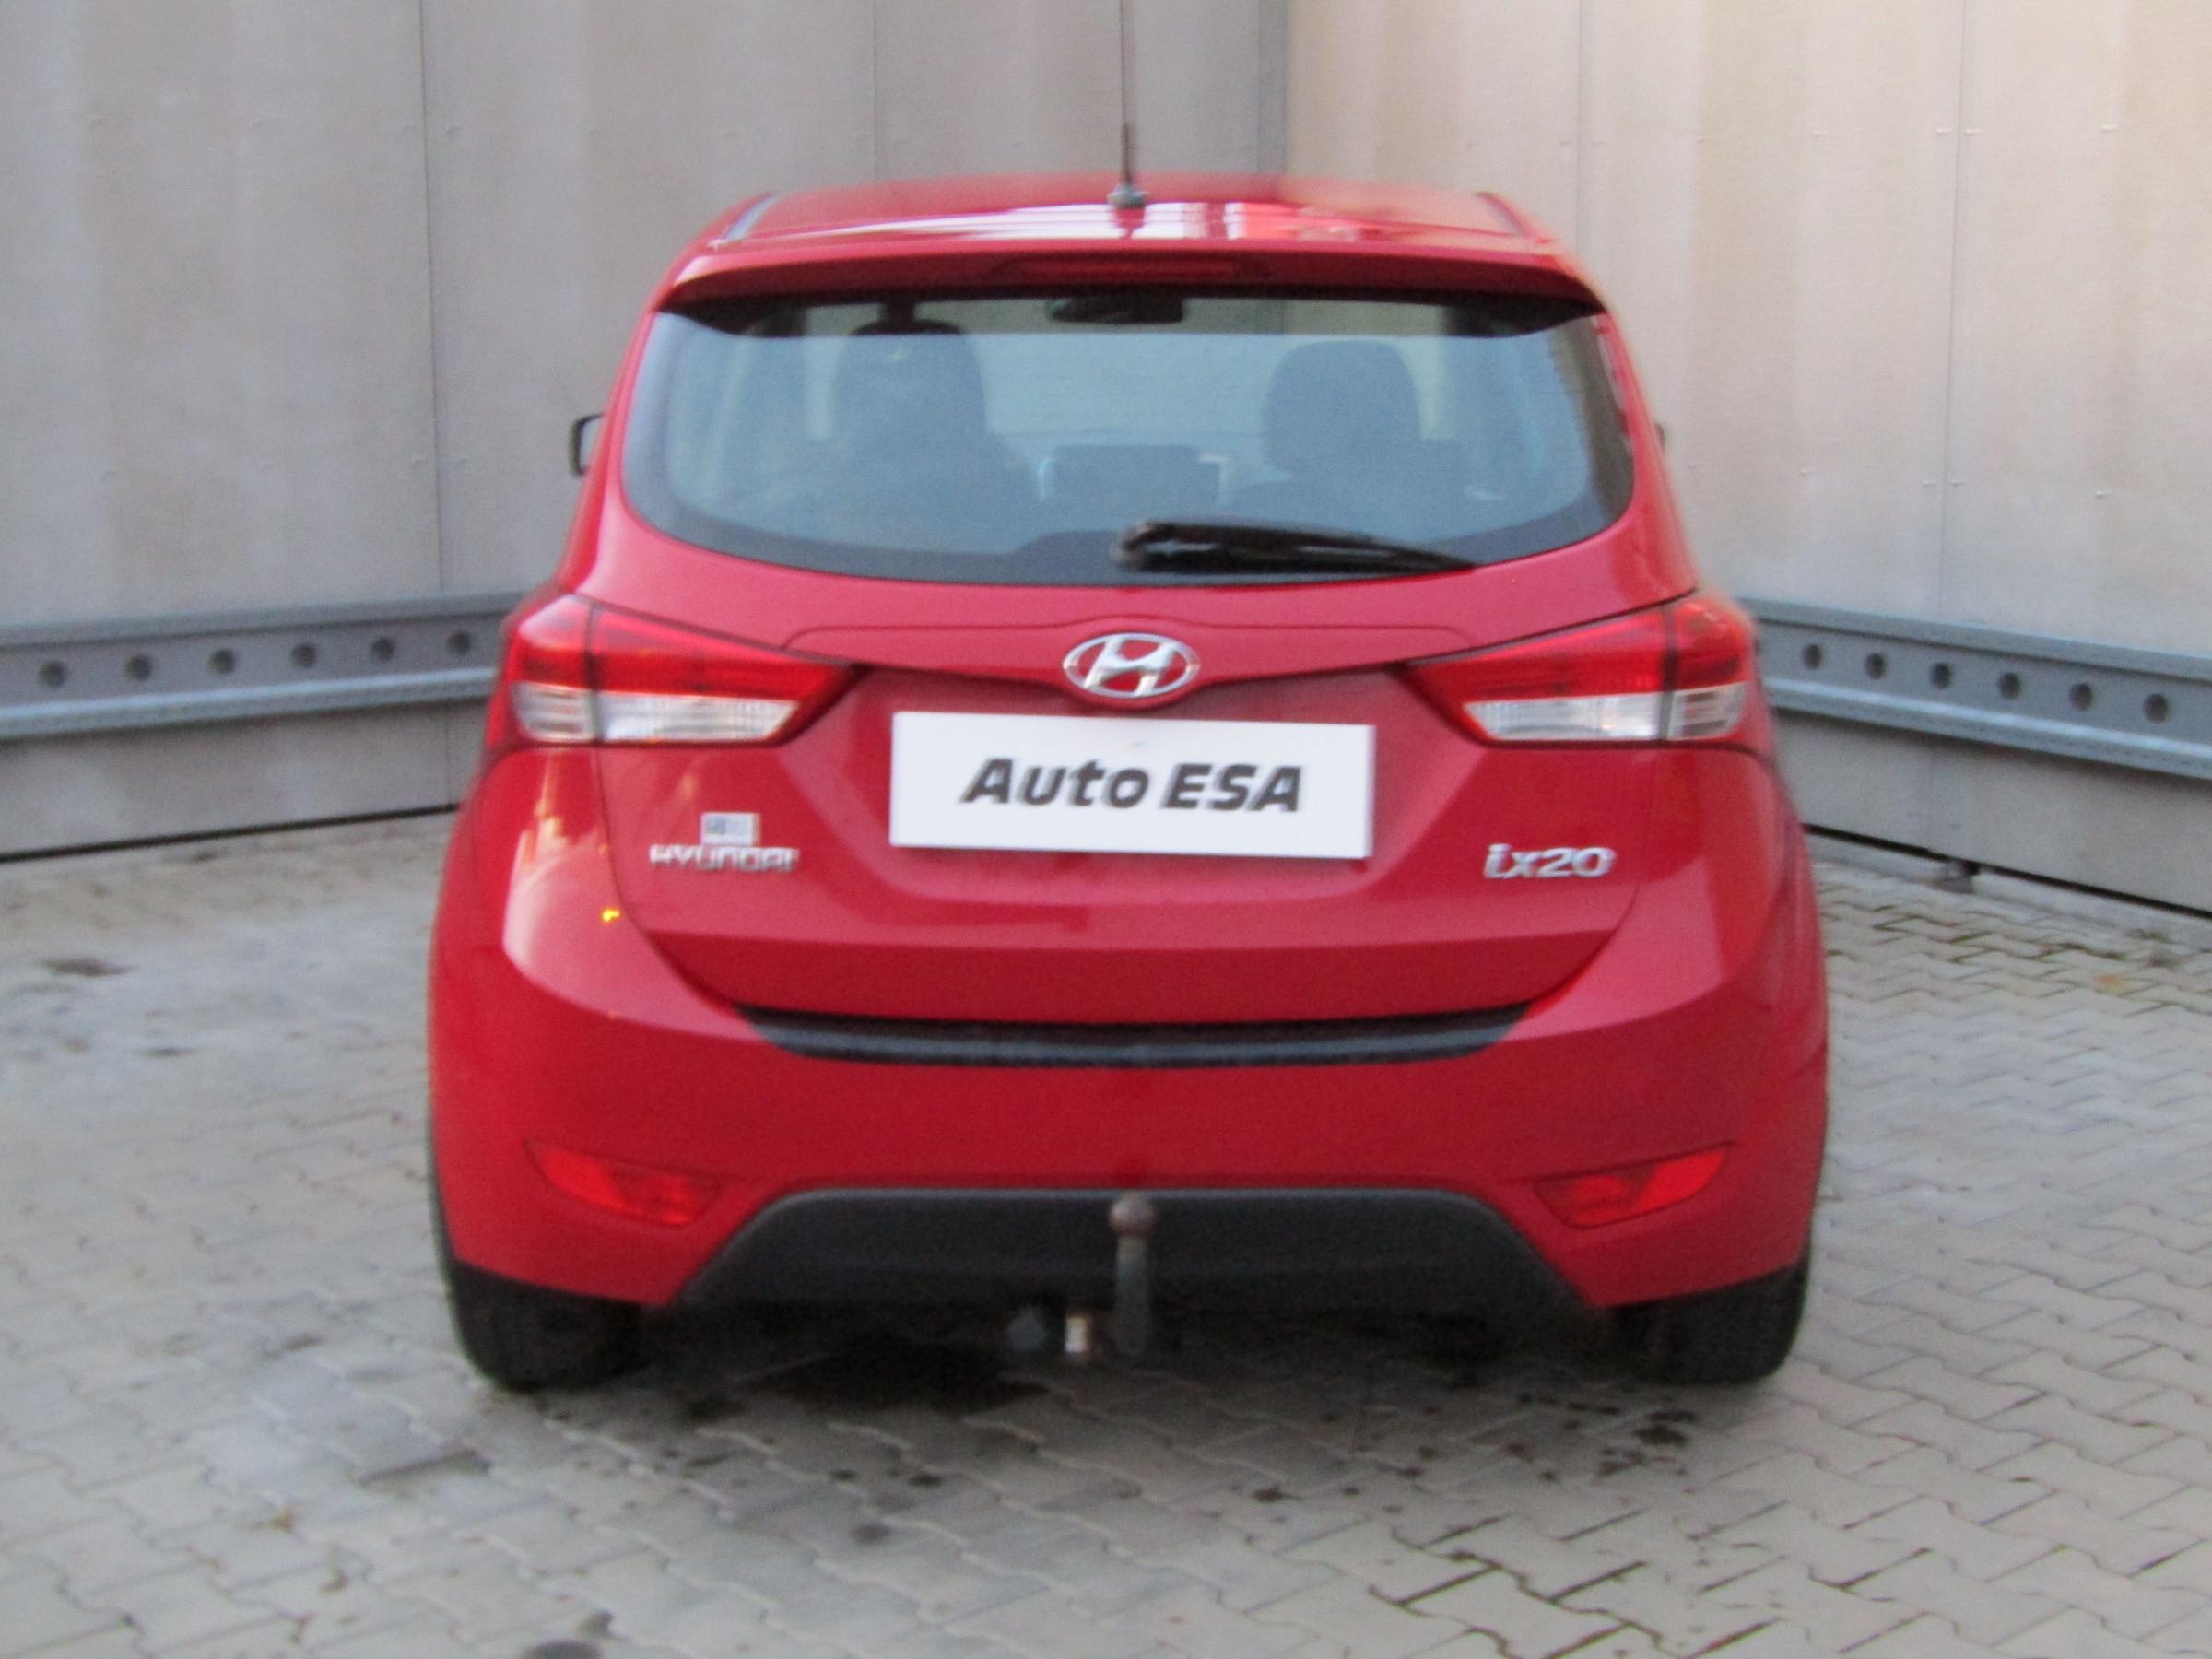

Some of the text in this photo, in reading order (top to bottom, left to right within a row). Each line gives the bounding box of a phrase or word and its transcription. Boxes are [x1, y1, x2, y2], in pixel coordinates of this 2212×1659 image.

[959, 757, 1302, 813] Auto ESA
[649, 843, 799, 872] HYUNDAI
[1484, 843, 1617, 879] ix20
